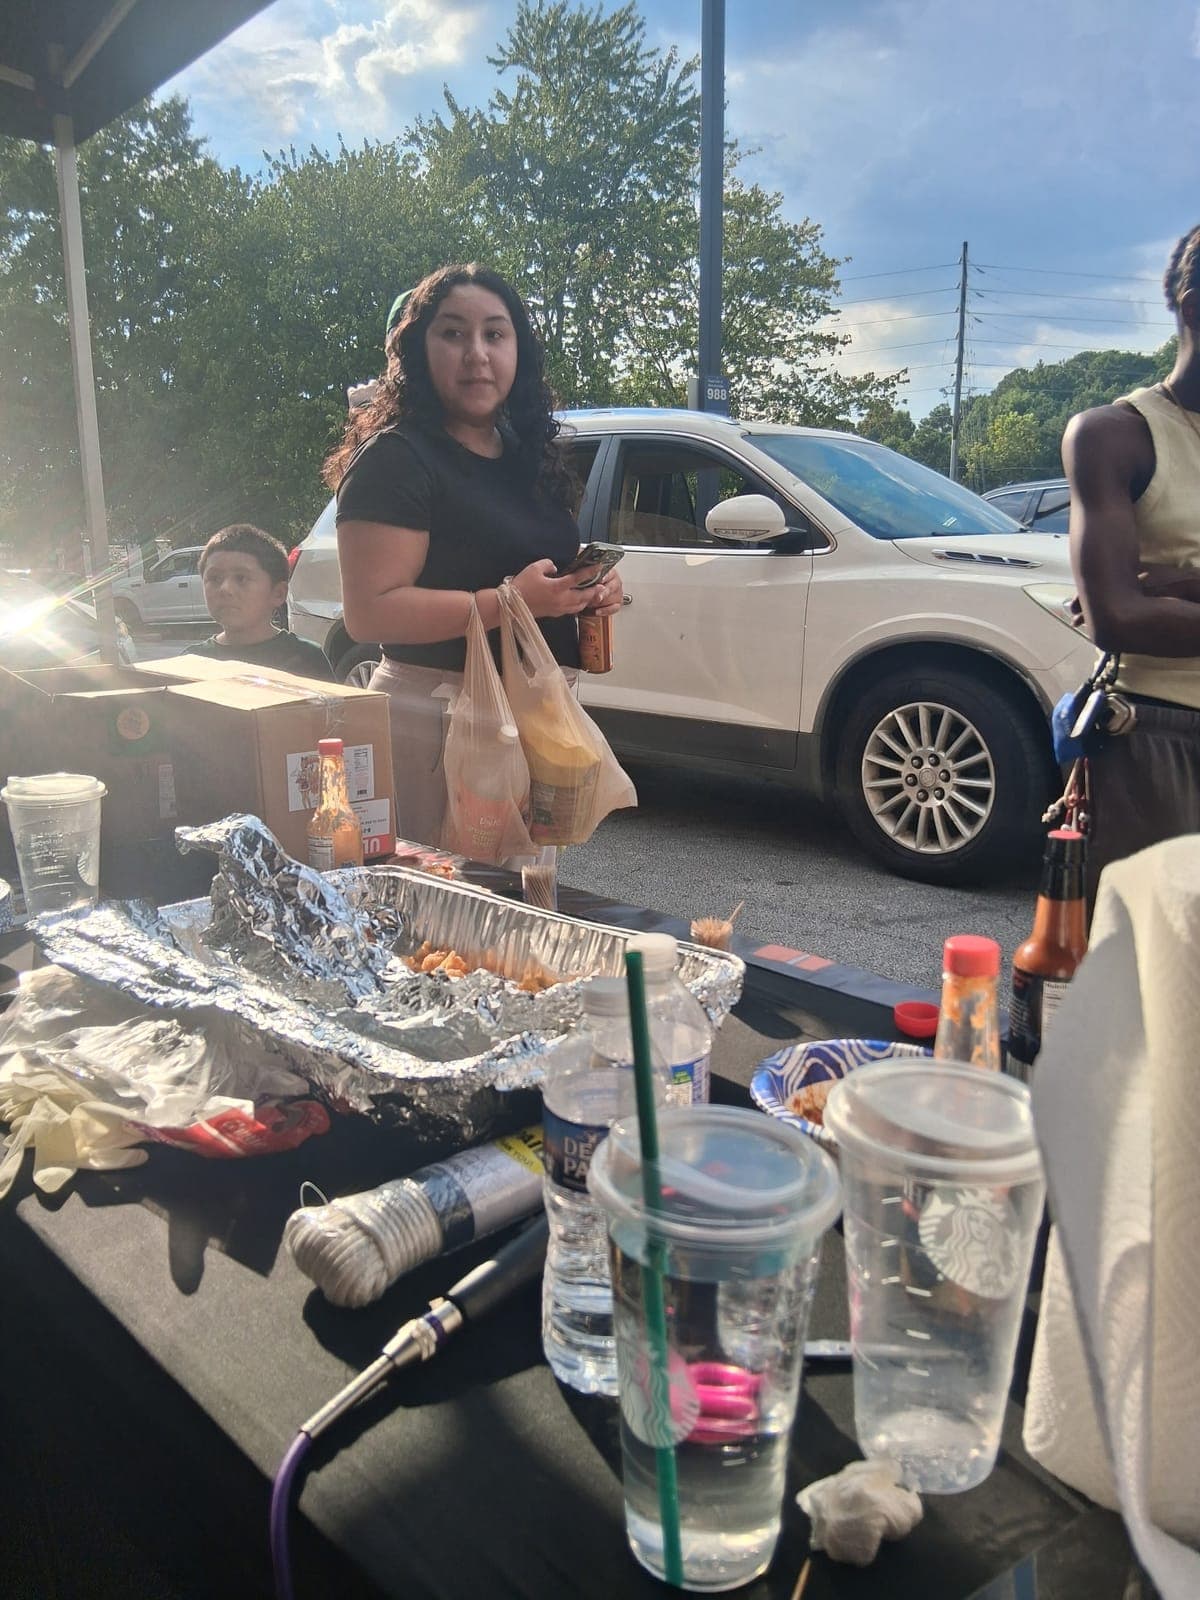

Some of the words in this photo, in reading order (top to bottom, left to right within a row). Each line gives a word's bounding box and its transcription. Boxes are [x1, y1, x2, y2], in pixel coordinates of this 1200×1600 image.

[707, 388, 727, 400] 988
[564, 1136, 594, 1158] DE
[564, 1156, 591, 1178] PA
